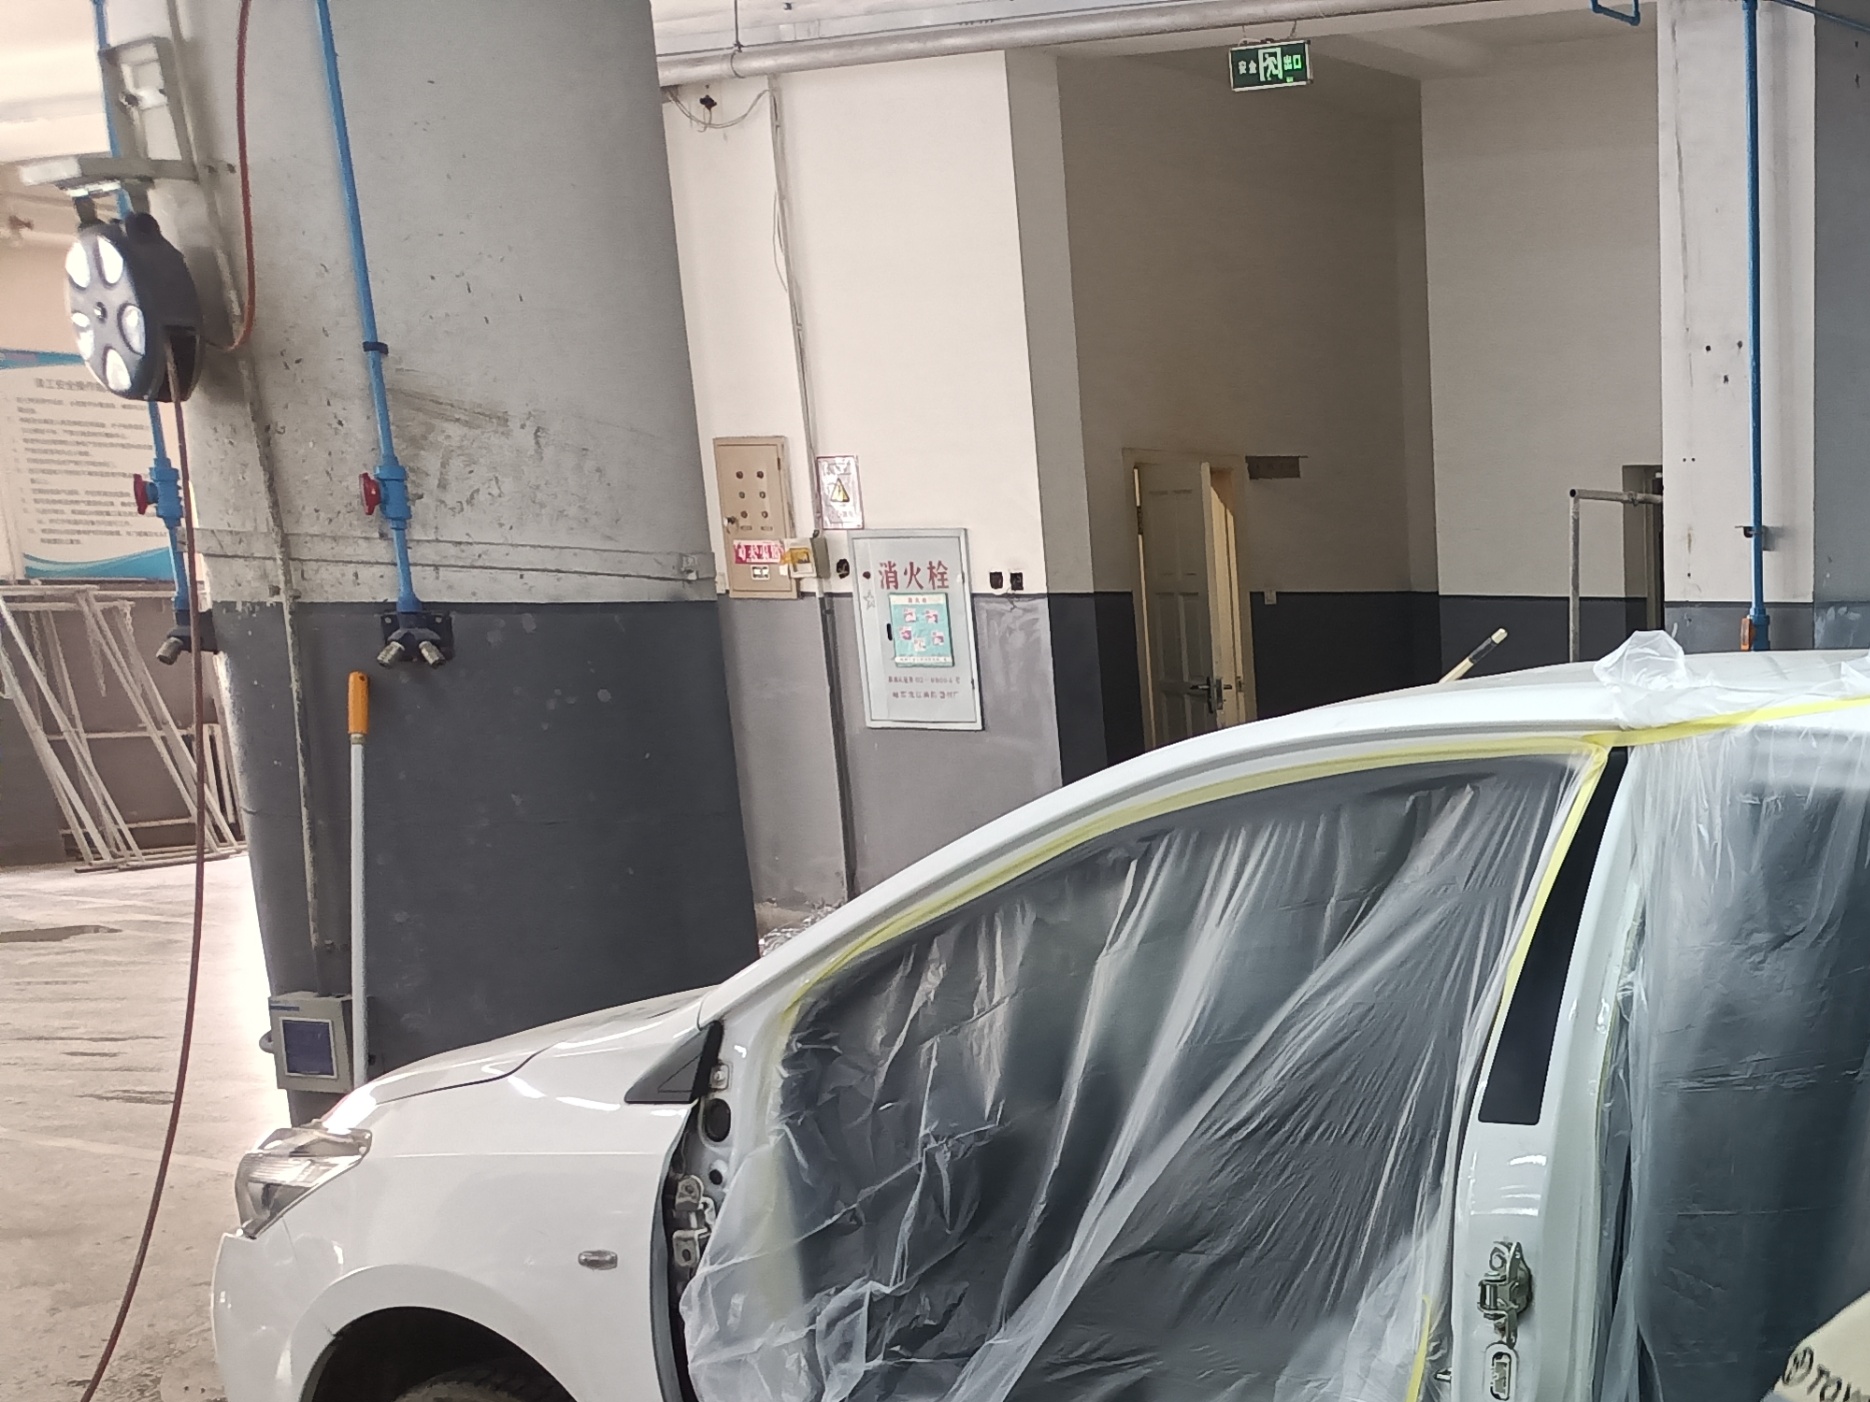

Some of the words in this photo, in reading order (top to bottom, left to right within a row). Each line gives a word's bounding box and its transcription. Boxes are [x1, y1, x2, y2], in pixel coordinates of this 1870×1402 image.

[1238, 60, 1257, 75] 安全
[1283, 54, 1302, 71] 出口
[878, 560, 949, 590] 消火栓
